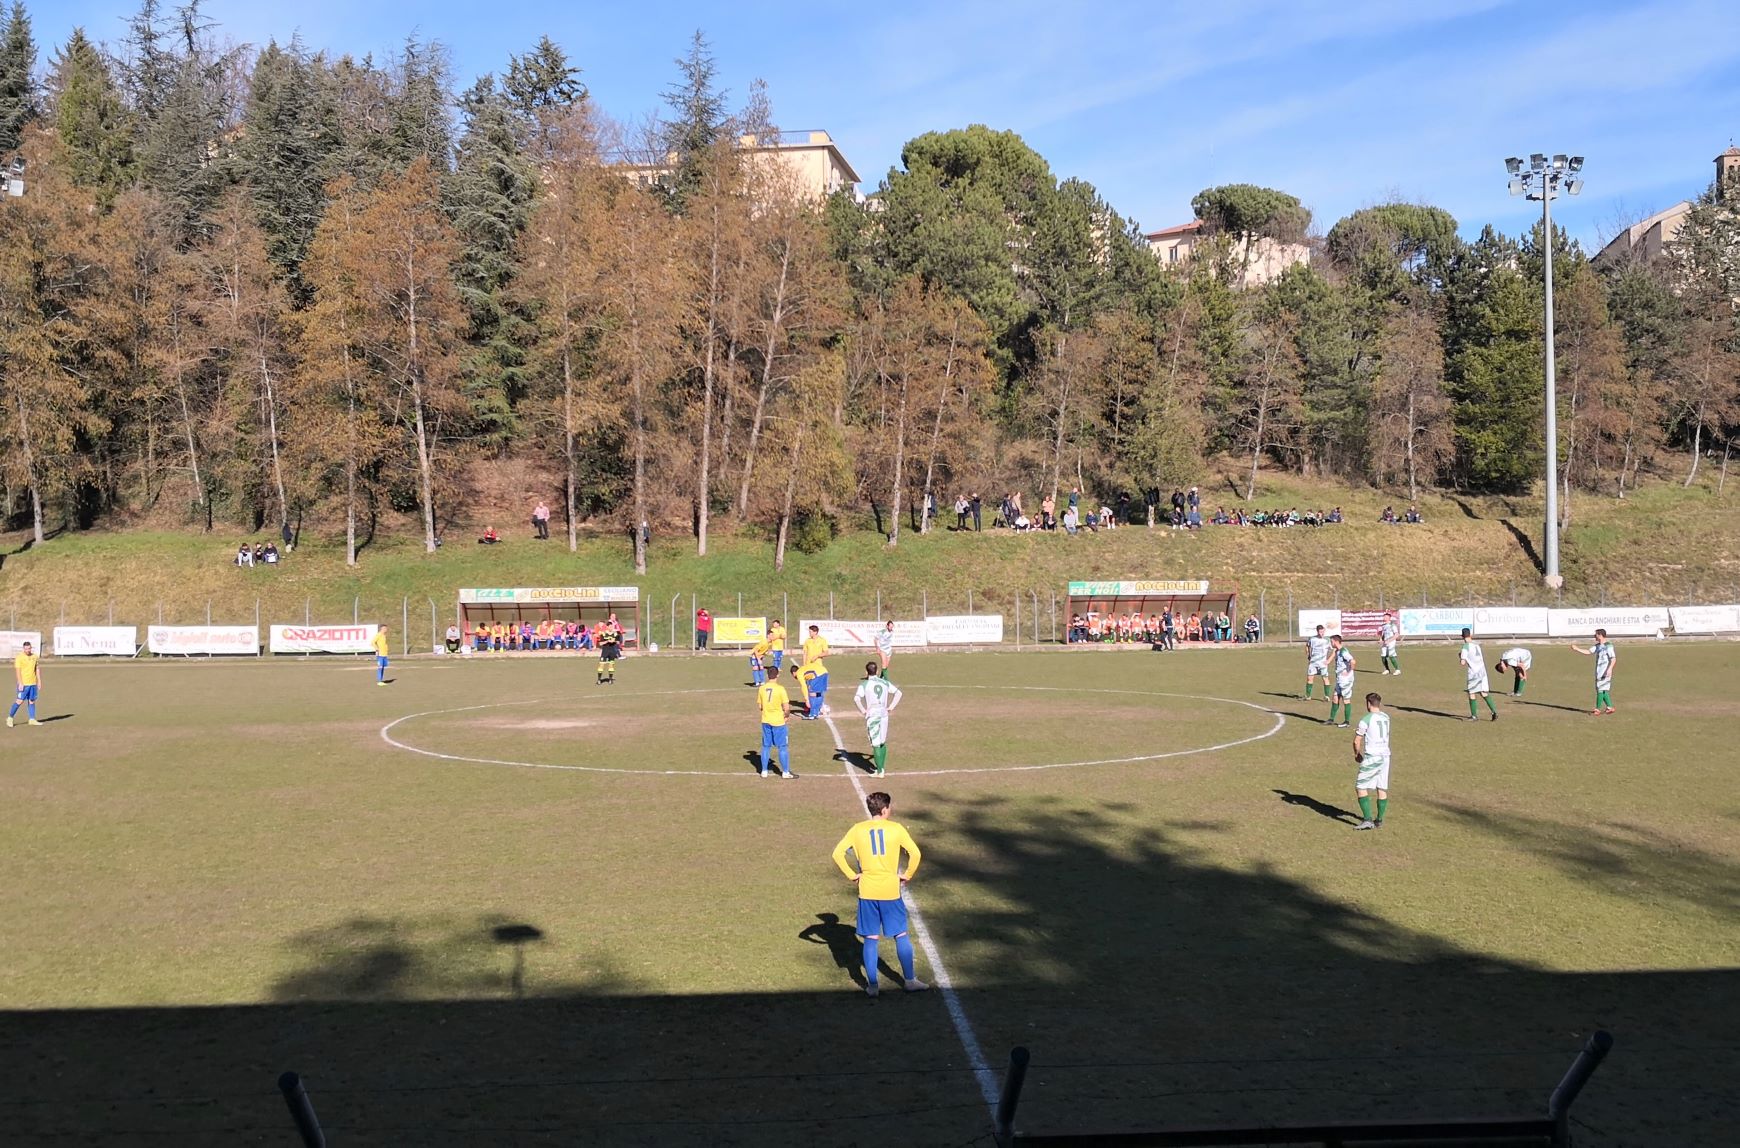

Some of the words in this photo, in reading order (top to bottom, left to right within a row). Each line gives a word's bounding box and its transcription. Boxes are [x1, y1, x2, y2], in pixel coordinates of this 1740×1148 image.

[1135, 581, 1201, 591] NOCCIOLINI
[530, 587, 600, 598] NOCCIOLINI
[1567, 617, 1587, 625] BANCA
[1595, 616, 1622, 624] ANGHIARI
[57, 636, 75, 648] La
[765, 688, 773, 702] 7
[873, 684, 885, 699] 9
[869, 828, 886, 855] 11
